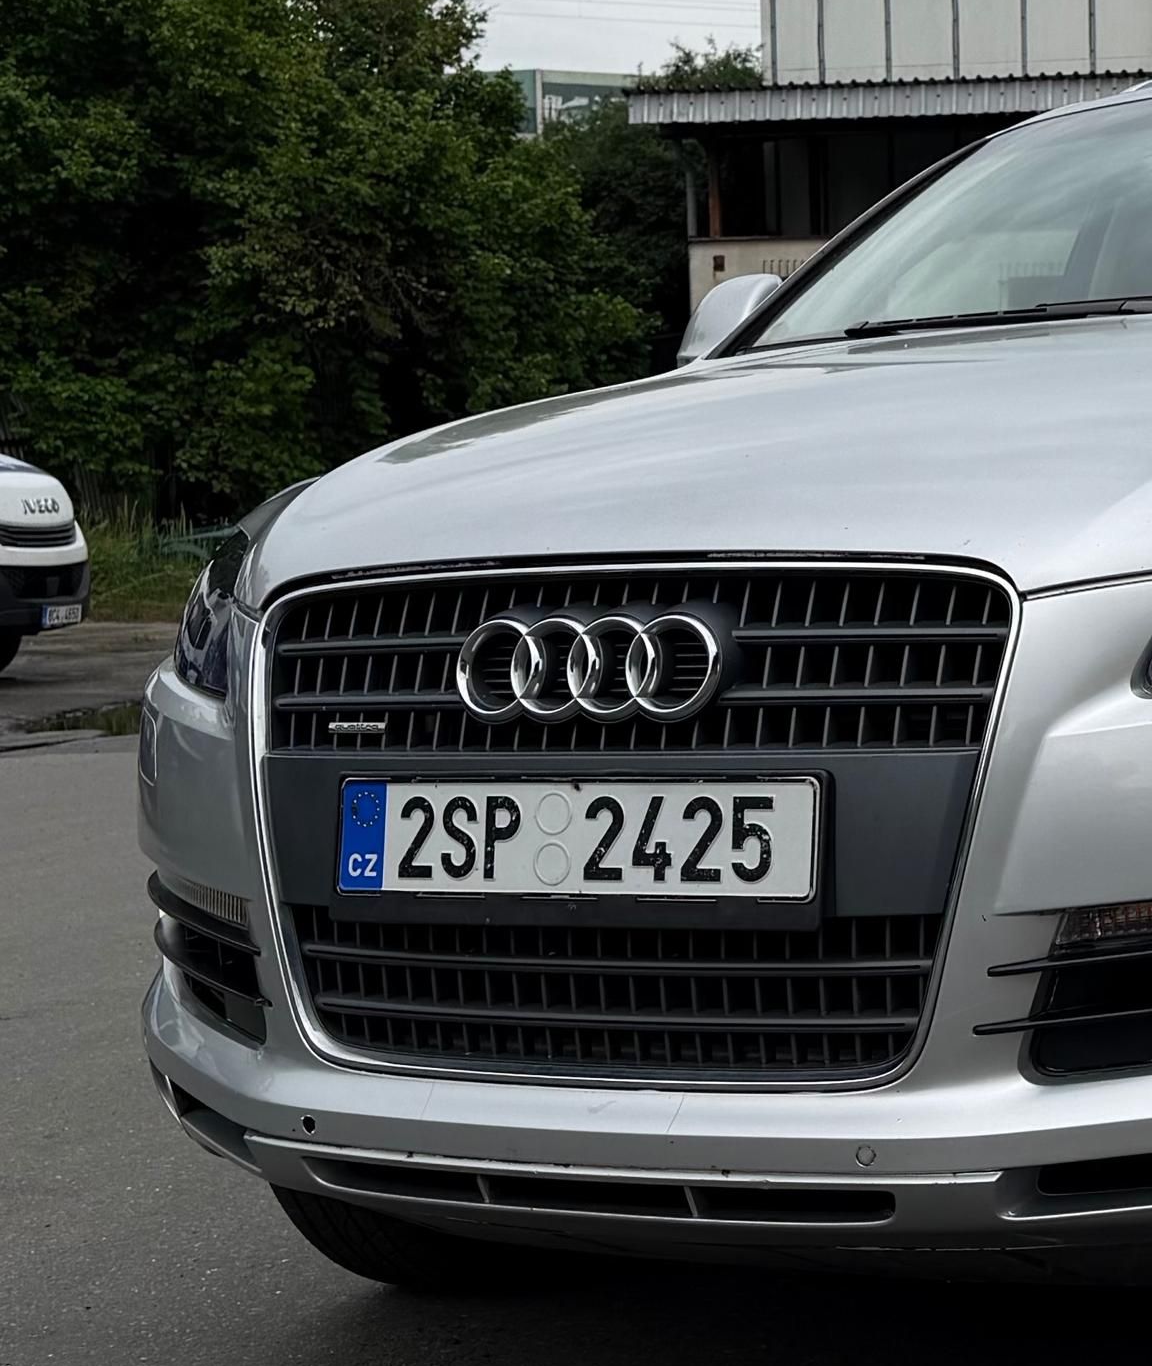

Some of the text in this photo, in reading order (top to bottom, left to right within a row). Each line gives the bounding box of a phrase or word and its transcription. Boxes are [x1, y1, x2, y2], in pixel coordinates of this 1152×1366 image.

[20, 497, 60, 515] IVECO
[334, 723, 380, 732] quattro
[398, 795, 775, 883] 2SP 2425
[348, 853, 378, 877] CZ
